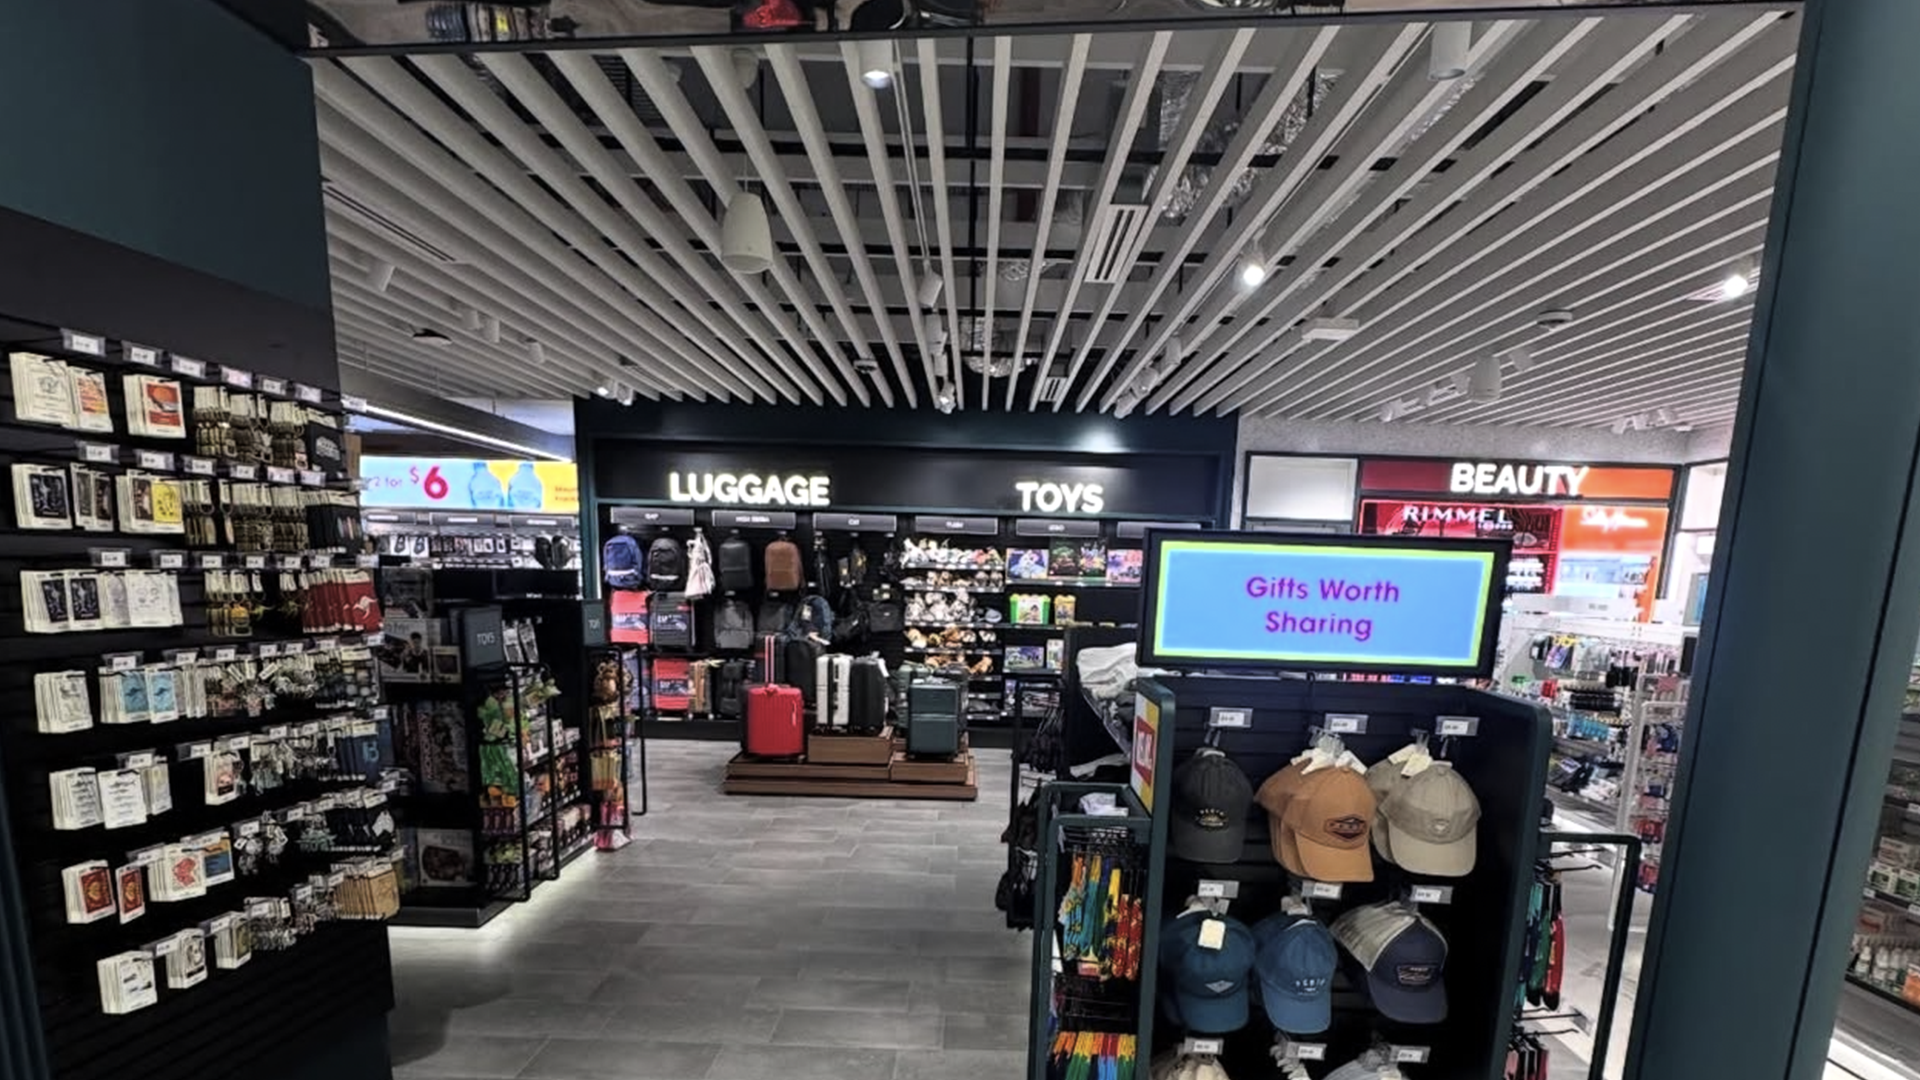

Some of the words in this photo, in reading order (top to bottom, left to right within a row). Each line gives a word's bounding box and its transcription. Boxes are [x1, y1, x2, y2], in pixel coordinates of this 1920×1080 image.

[669, 472, 830, 506] LUGGAGE
[1450, 463, 1588, 496] BEAUTY
[1015, 481, 1104, 514] TOYS
[1403, 506, 1513, 525] RIMMEL
[1247, 576, 1309, 599] Gifts
[1320, 579, 1400, 602] Worth
[1265, 610, 1374, 642] Sharing
